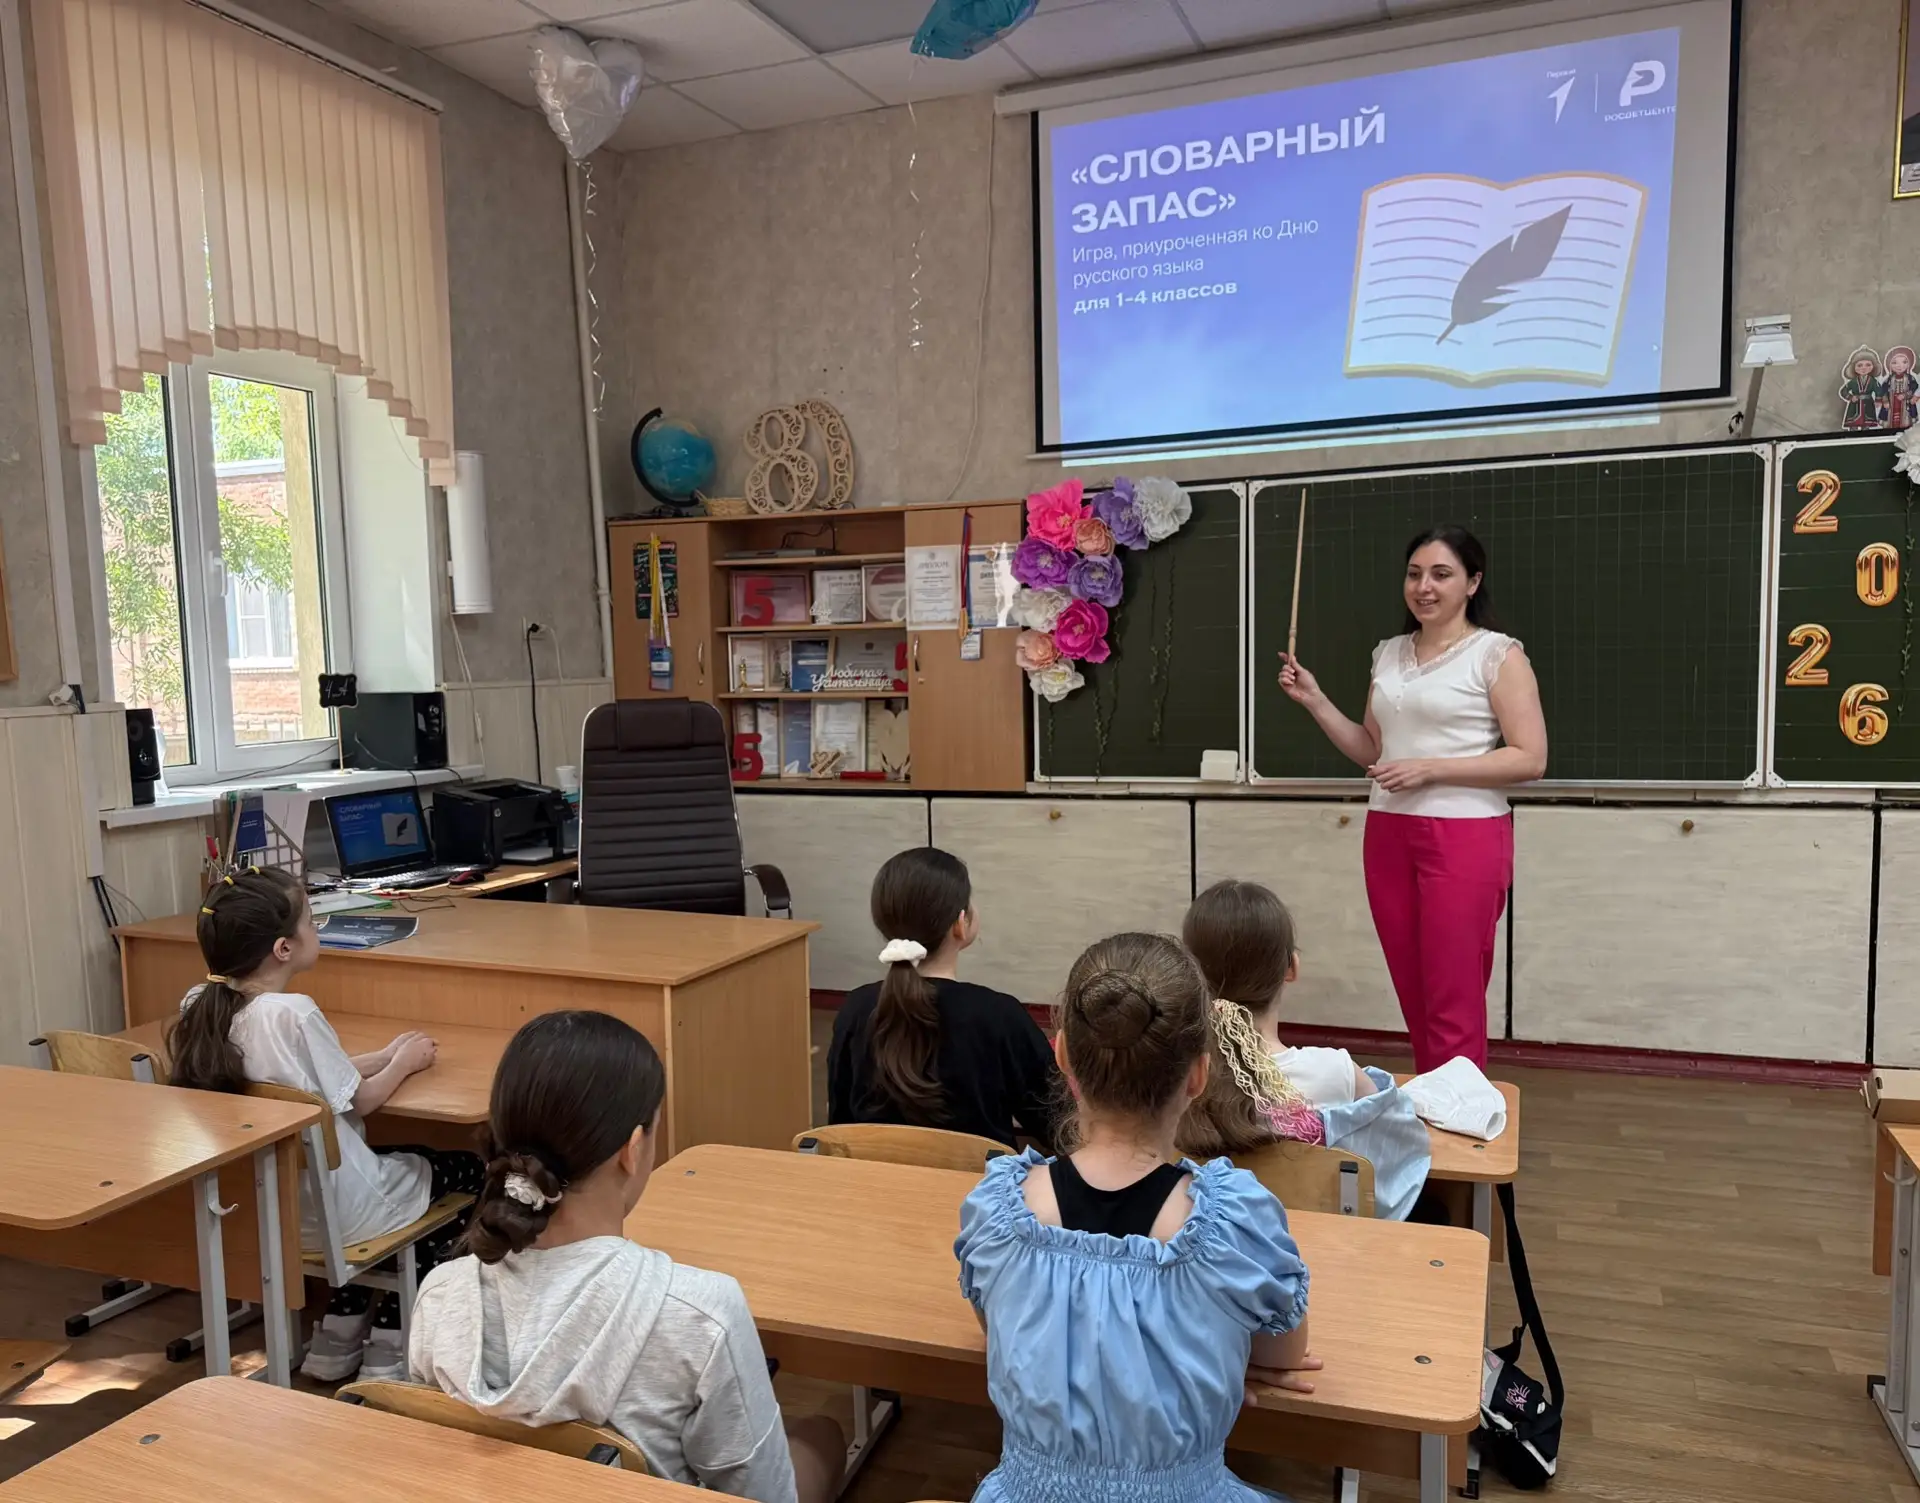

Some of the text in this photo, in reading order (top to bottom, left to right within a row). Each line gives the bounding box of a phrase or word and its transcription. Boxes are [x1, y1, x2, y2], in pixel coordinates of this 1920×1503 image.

[1071, 105, 1385, 185] «СЛОВАРНЫЙ
[1071, 187, 1236, 234] ЗАПАС»
[1072, 220, 1319, 264] Игра, приуроченная ко Дню
[1073, 258, 1204, 289] русского языка
[1073, 296, 1110, 315] для
[1152, 282, 1238, 304] классов
[1793, 469, 1841, 534] 2
[1856, 542, 1899, 608] 0
[741, 575, 775, 626] 5
[824, 663, 886, 678] Любимая
[1785, 623, 1832, 687] 2
[1838, 682, 1890, 746] 6
[732, 733, 763, 781] 5
